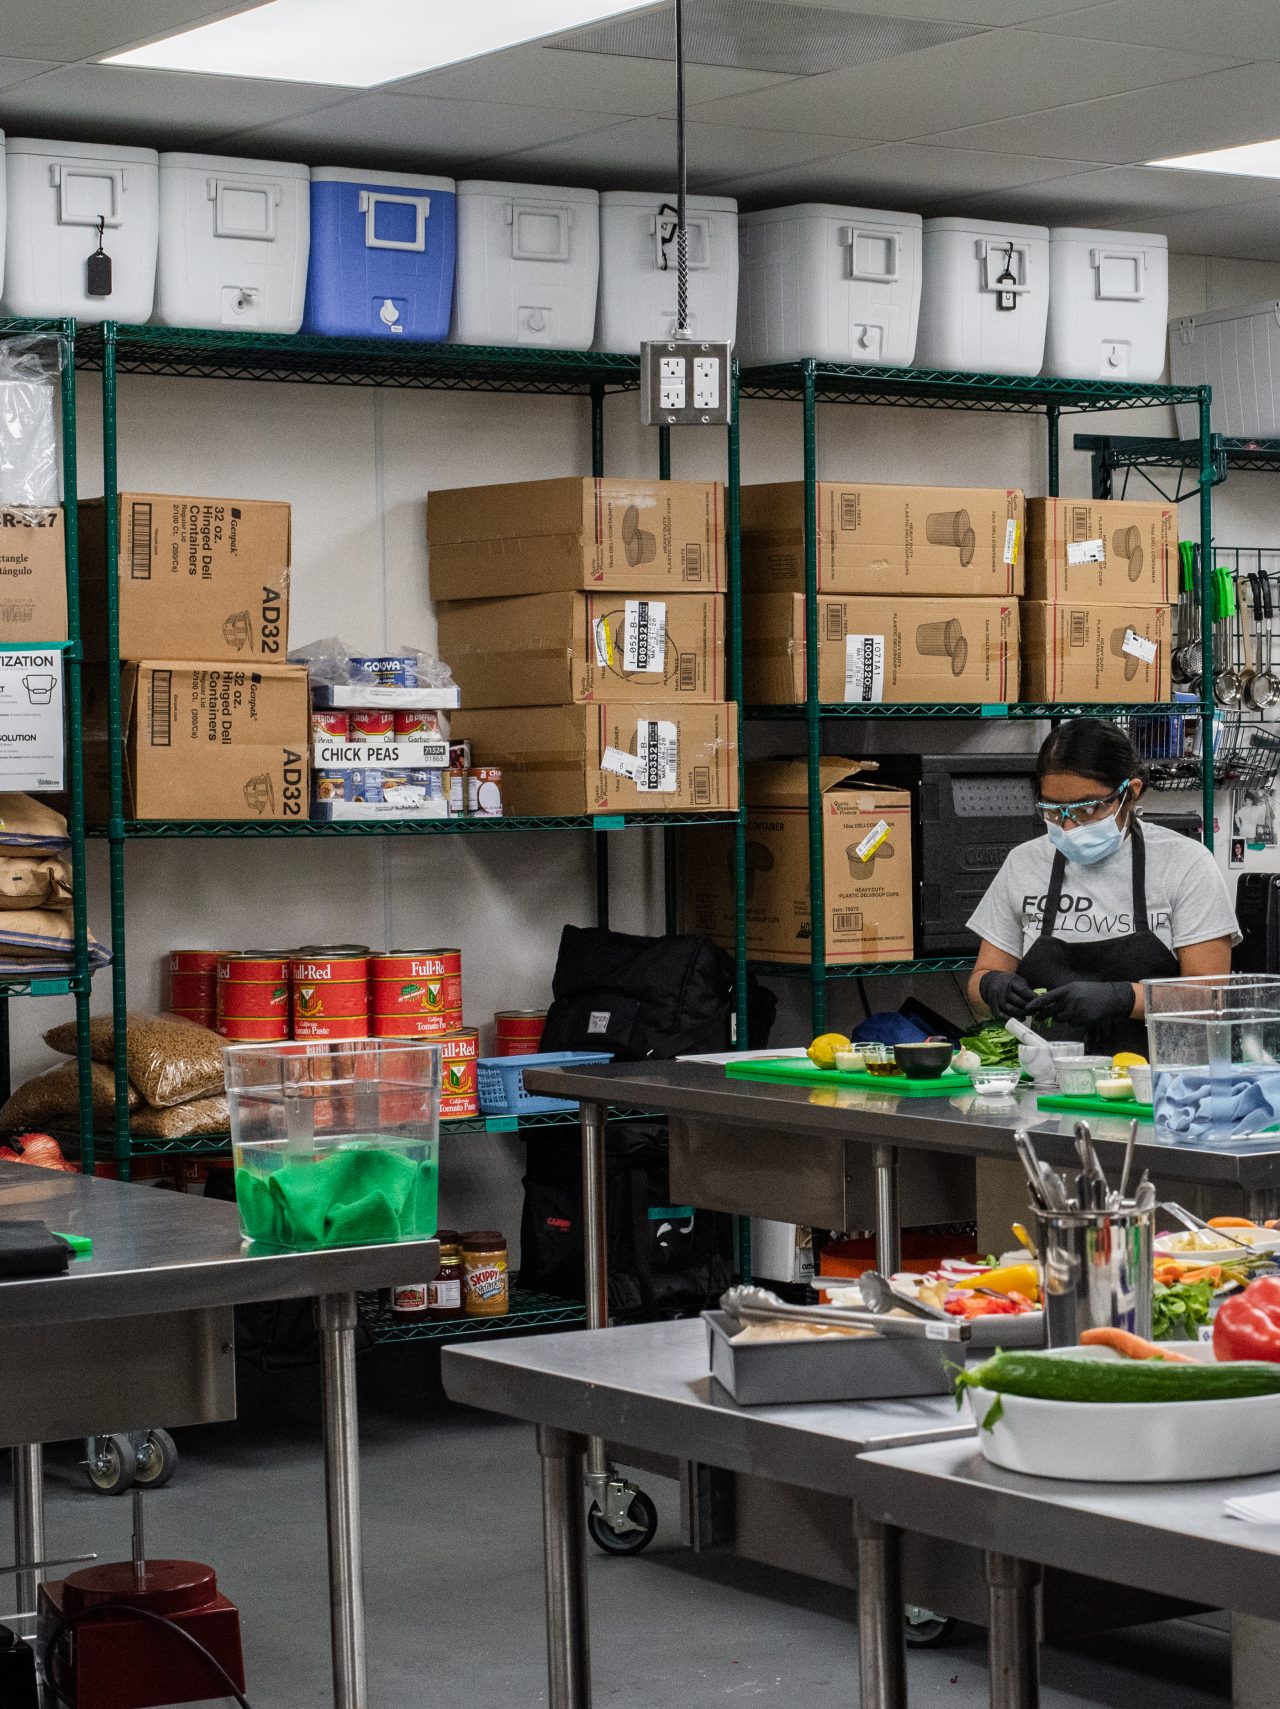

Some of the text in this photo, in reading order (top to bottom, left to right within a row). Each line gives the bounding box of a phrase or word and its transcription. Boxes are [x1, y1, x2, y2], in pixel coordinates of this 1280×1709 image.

[189, 505, 200, 575] Containers
[200, 505, 212, 579] Hinged Deli
[214, 507, 224, 543] 32 oz.
[229, 520, 238, 553] Genpak
[261, 586, 280, 653] AD32
[639, 621, 647, 666] 1003321
[208, 671, 220, 741] Containers
[220, 671, 233, 744] Hinged Deli
[234, 672, 245, 709] 32 oz.
[249, 684, 257, 718] Genpak
[321, 747, 399, 761] CHICK PEAS
[283, 748, 301, 816] AD32
[1022, 894, 1093, 914] FOOD
[312, 1026, 330, 1035] Paste
[416, 1022, 439, 1030] Tomato
[470, 1270, 499, 1286] SKIPPY
